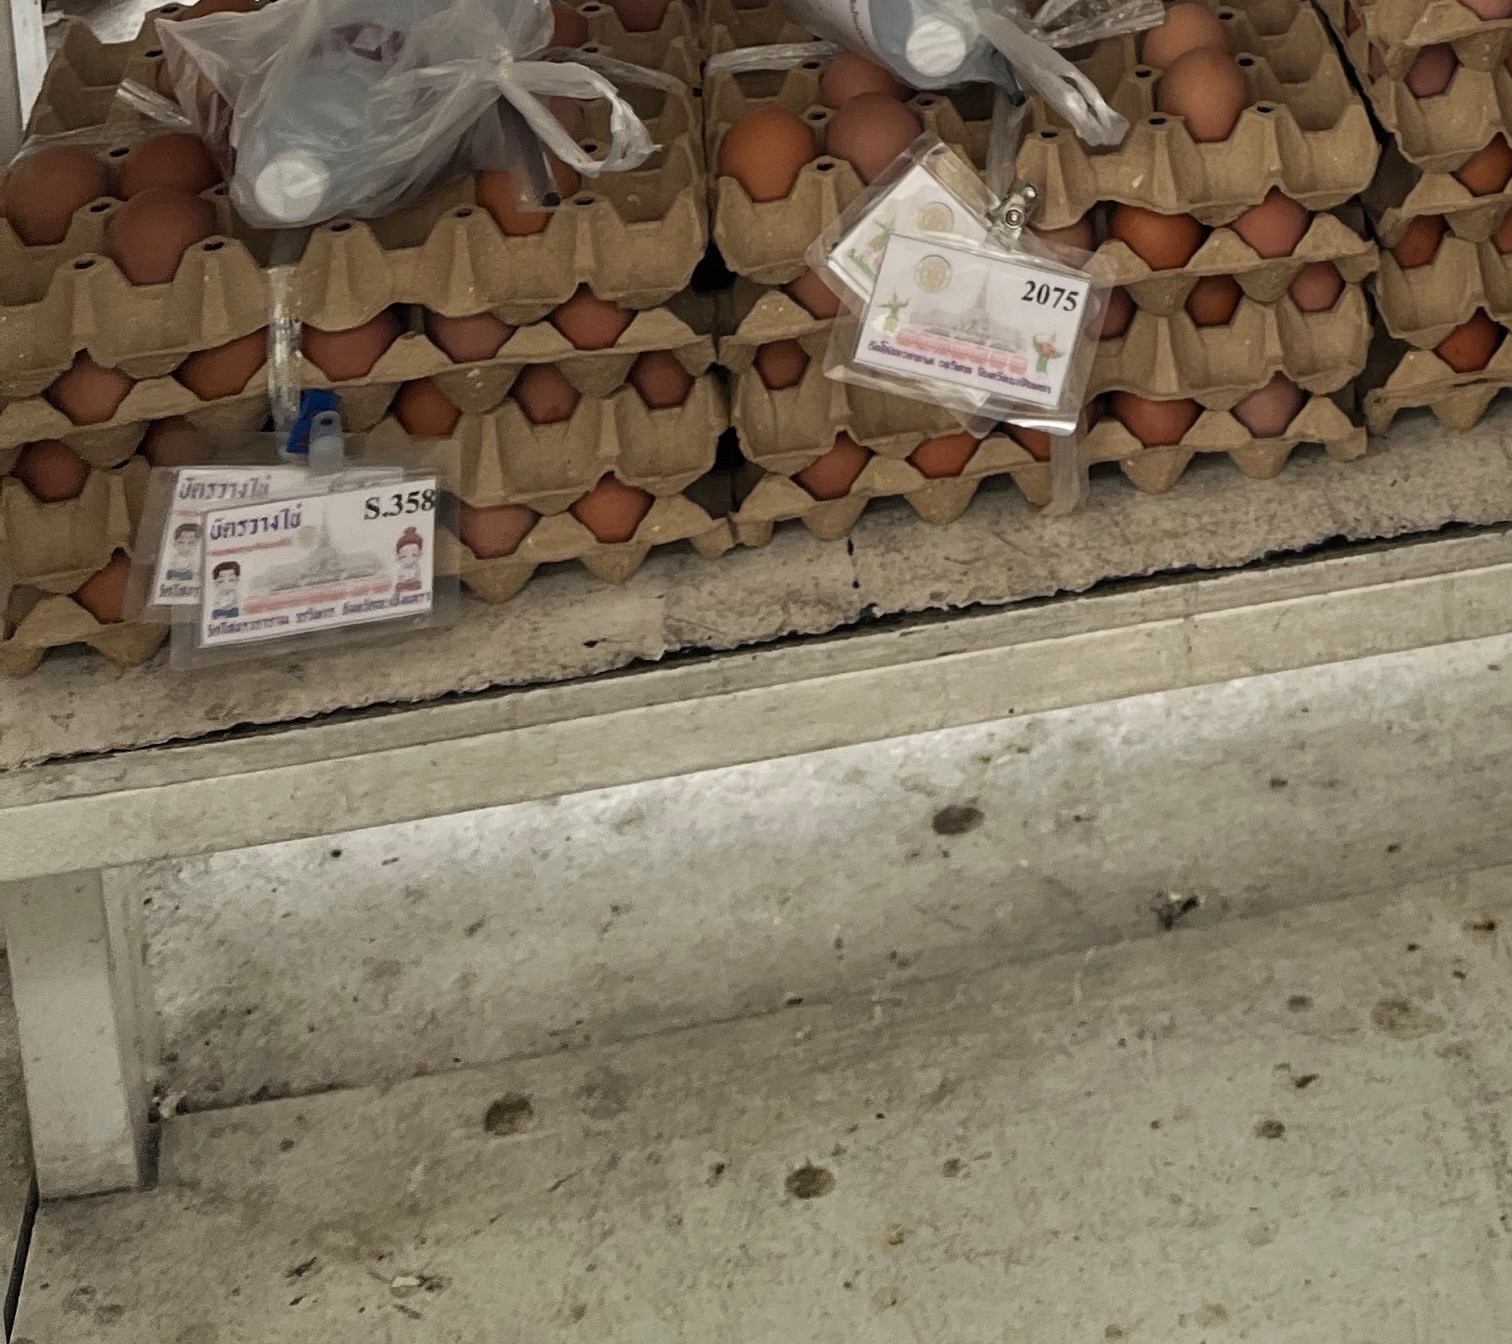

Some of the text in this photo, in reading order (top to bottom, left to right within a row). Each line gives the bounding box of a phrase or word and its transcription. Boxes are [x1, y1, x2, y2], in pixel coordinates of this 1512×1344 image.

[1021, 280, 1080, 312] 2075
[363, 489, 436, 521] S.358
[209, 504, 303, 541] บัตรวางไข่
